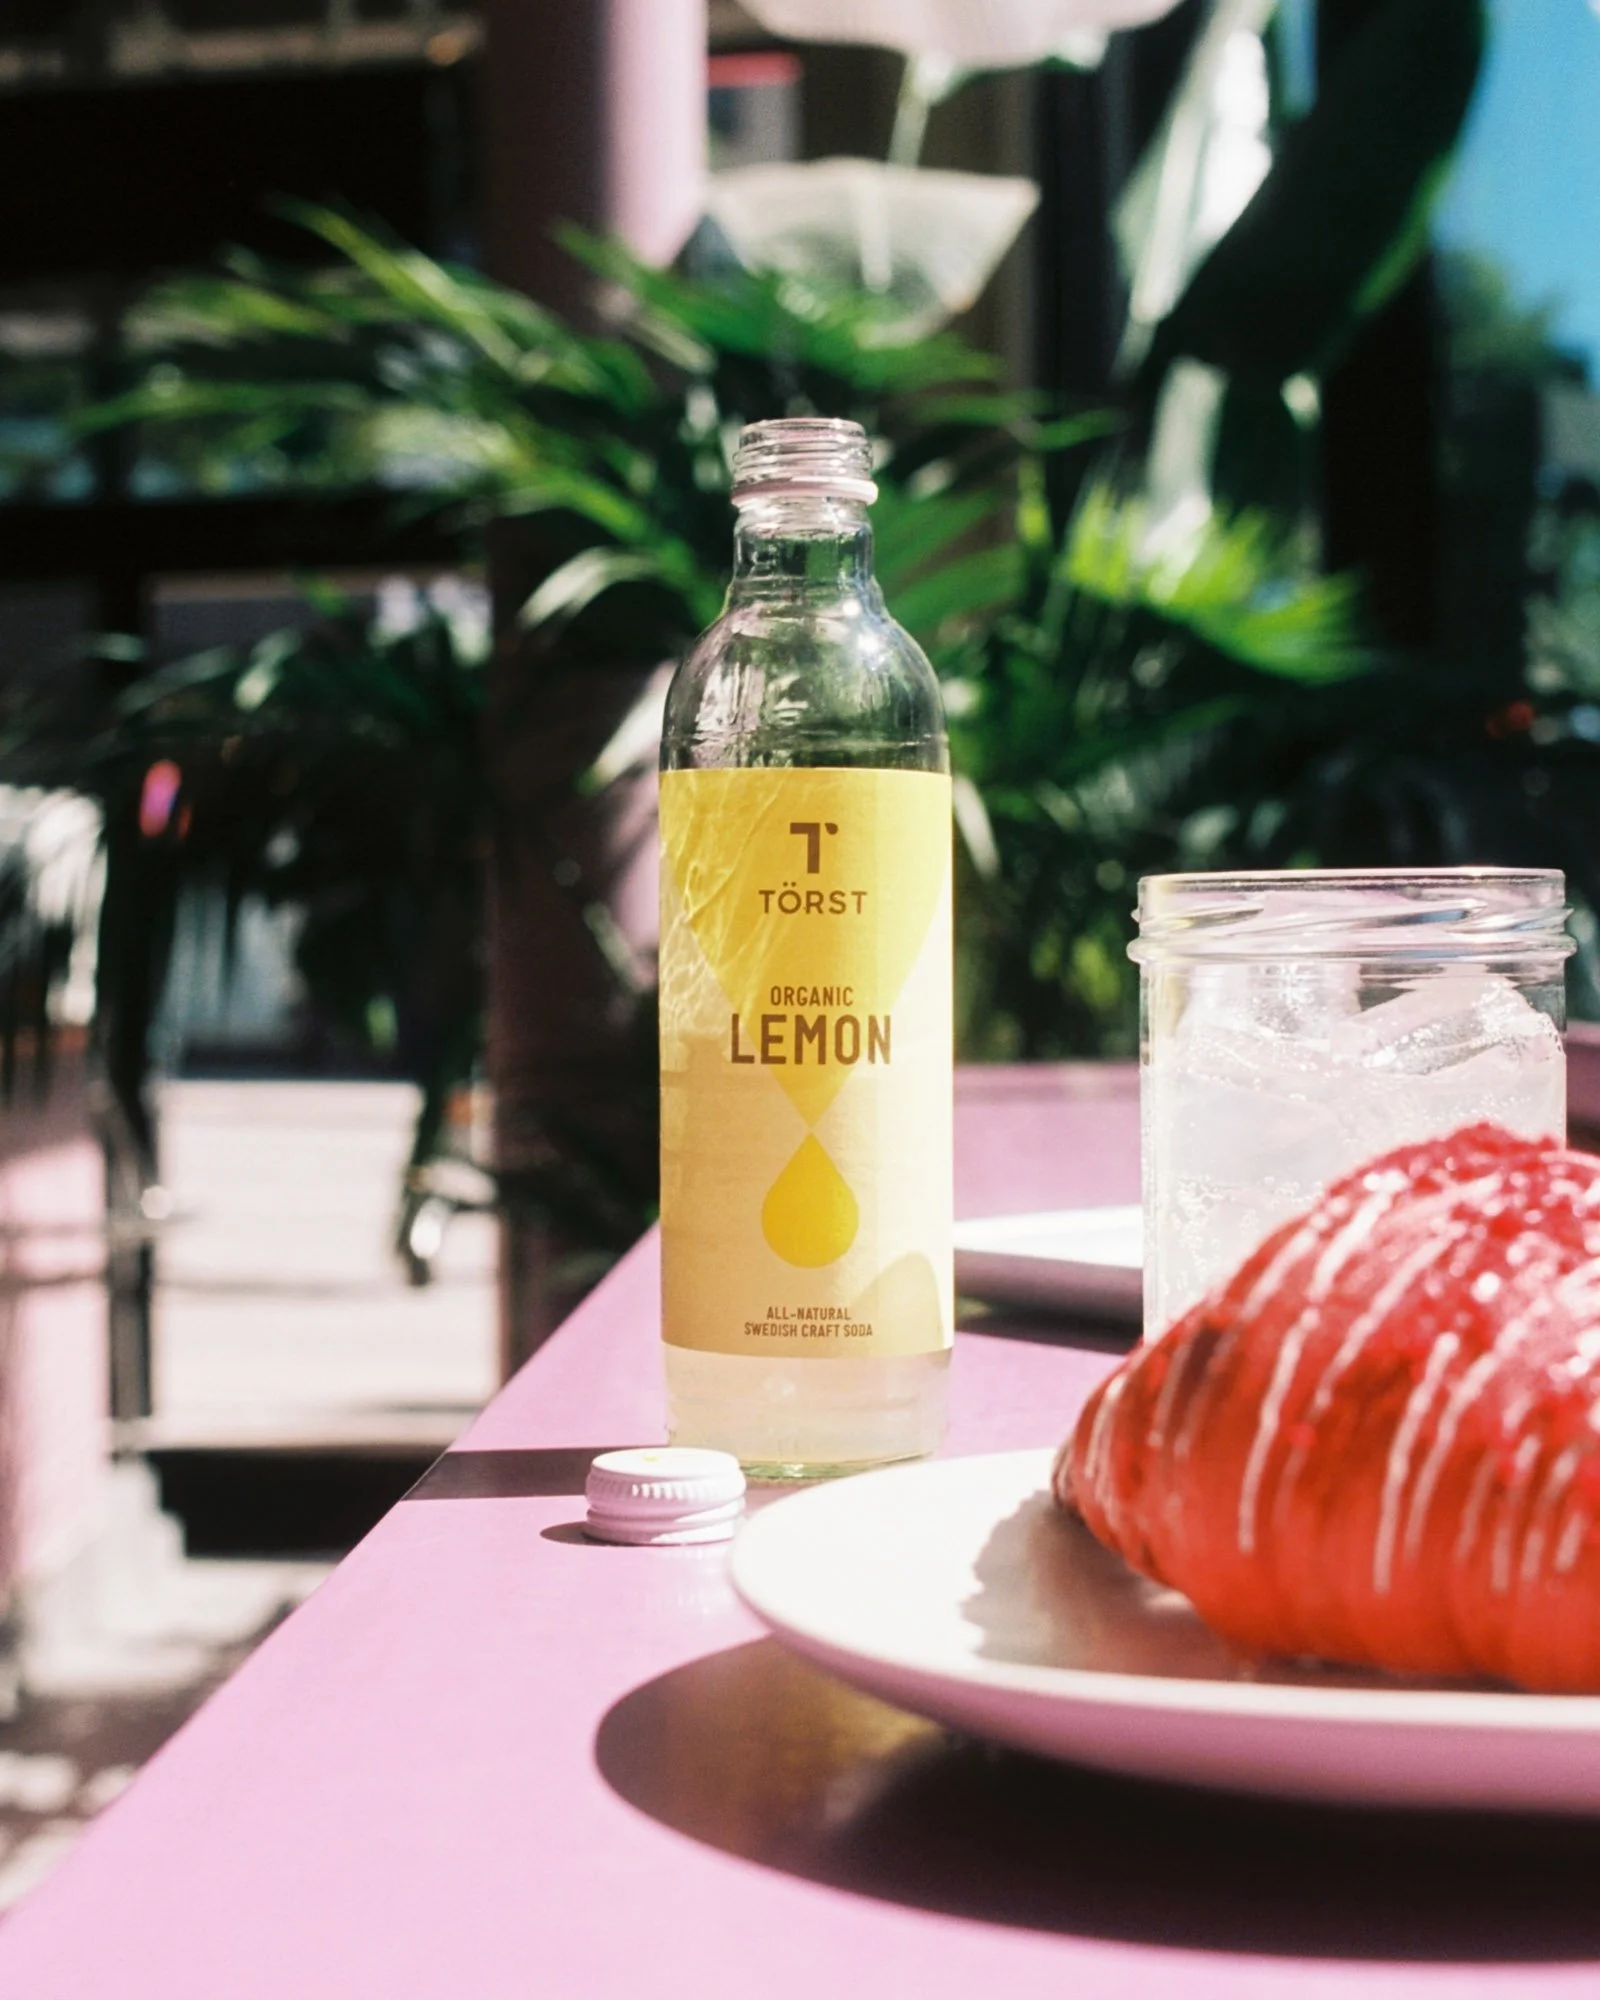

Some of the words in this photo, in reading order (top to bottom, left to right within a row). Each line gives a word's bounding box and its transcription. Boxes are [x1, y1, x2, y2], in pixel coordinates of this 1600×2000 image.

[758, 881, 868, 915] TÖRST
[770, 985, 854, 1007] ORGANIC
[731, 1013, 891, 1065] LEMON
[766, 1306, 852, 1321] ALL-NATURAL
[744, 1322, 798, 1337] SWEDISH
[801, 1323, 840, 1338] CRAFT
[843, 1323, 873, 1338] SODA
